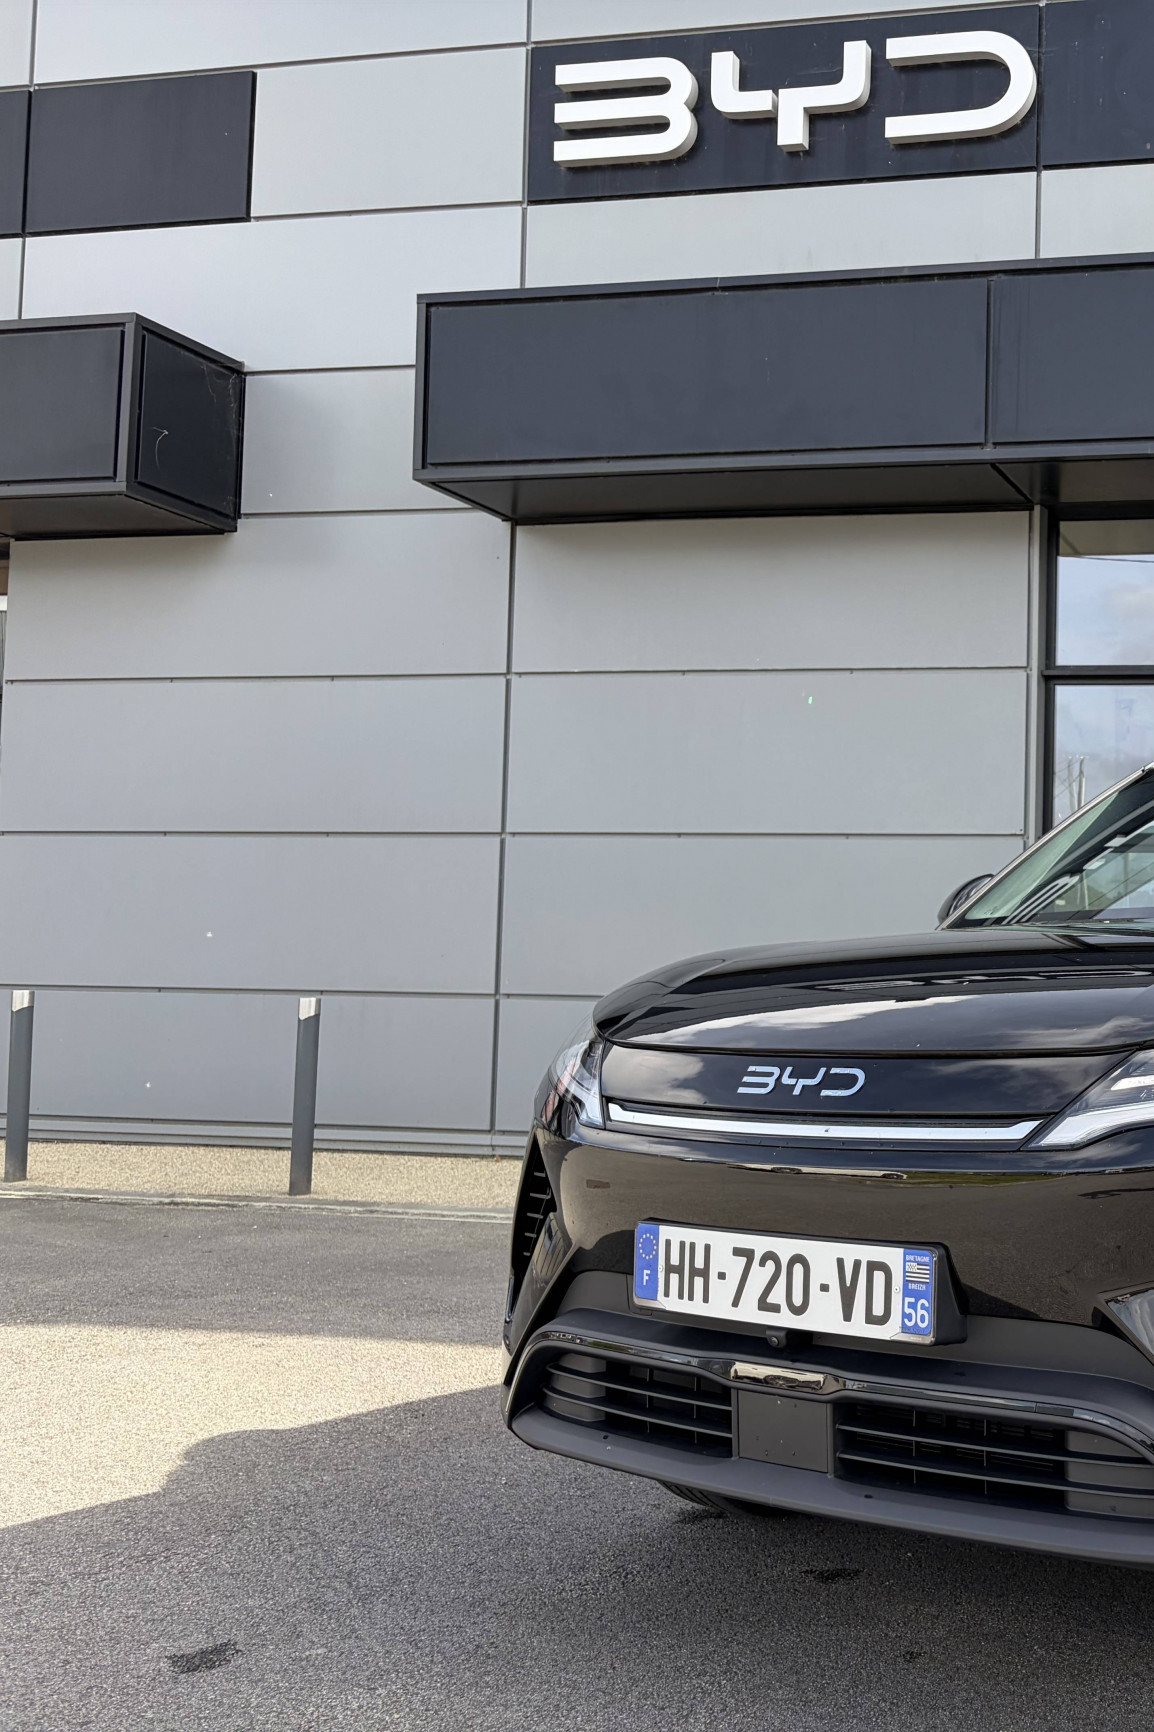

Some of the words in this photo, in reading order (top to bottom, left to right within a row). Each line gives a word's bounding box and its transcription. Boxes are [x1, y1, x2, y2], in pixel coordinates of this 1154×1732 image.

[553, 30, 1037, 168] BYD
[737, 1066, 866, 1097] BYD
[905, 1254, 930, 1263] BRETAGNE
[643, 1269, 651, 1286] F
[663, 1238, 893, 1326] HH-720-VD
[908, 1282, 927, 1291] BREIZH
[904, 1296, 930, 1329] 56
